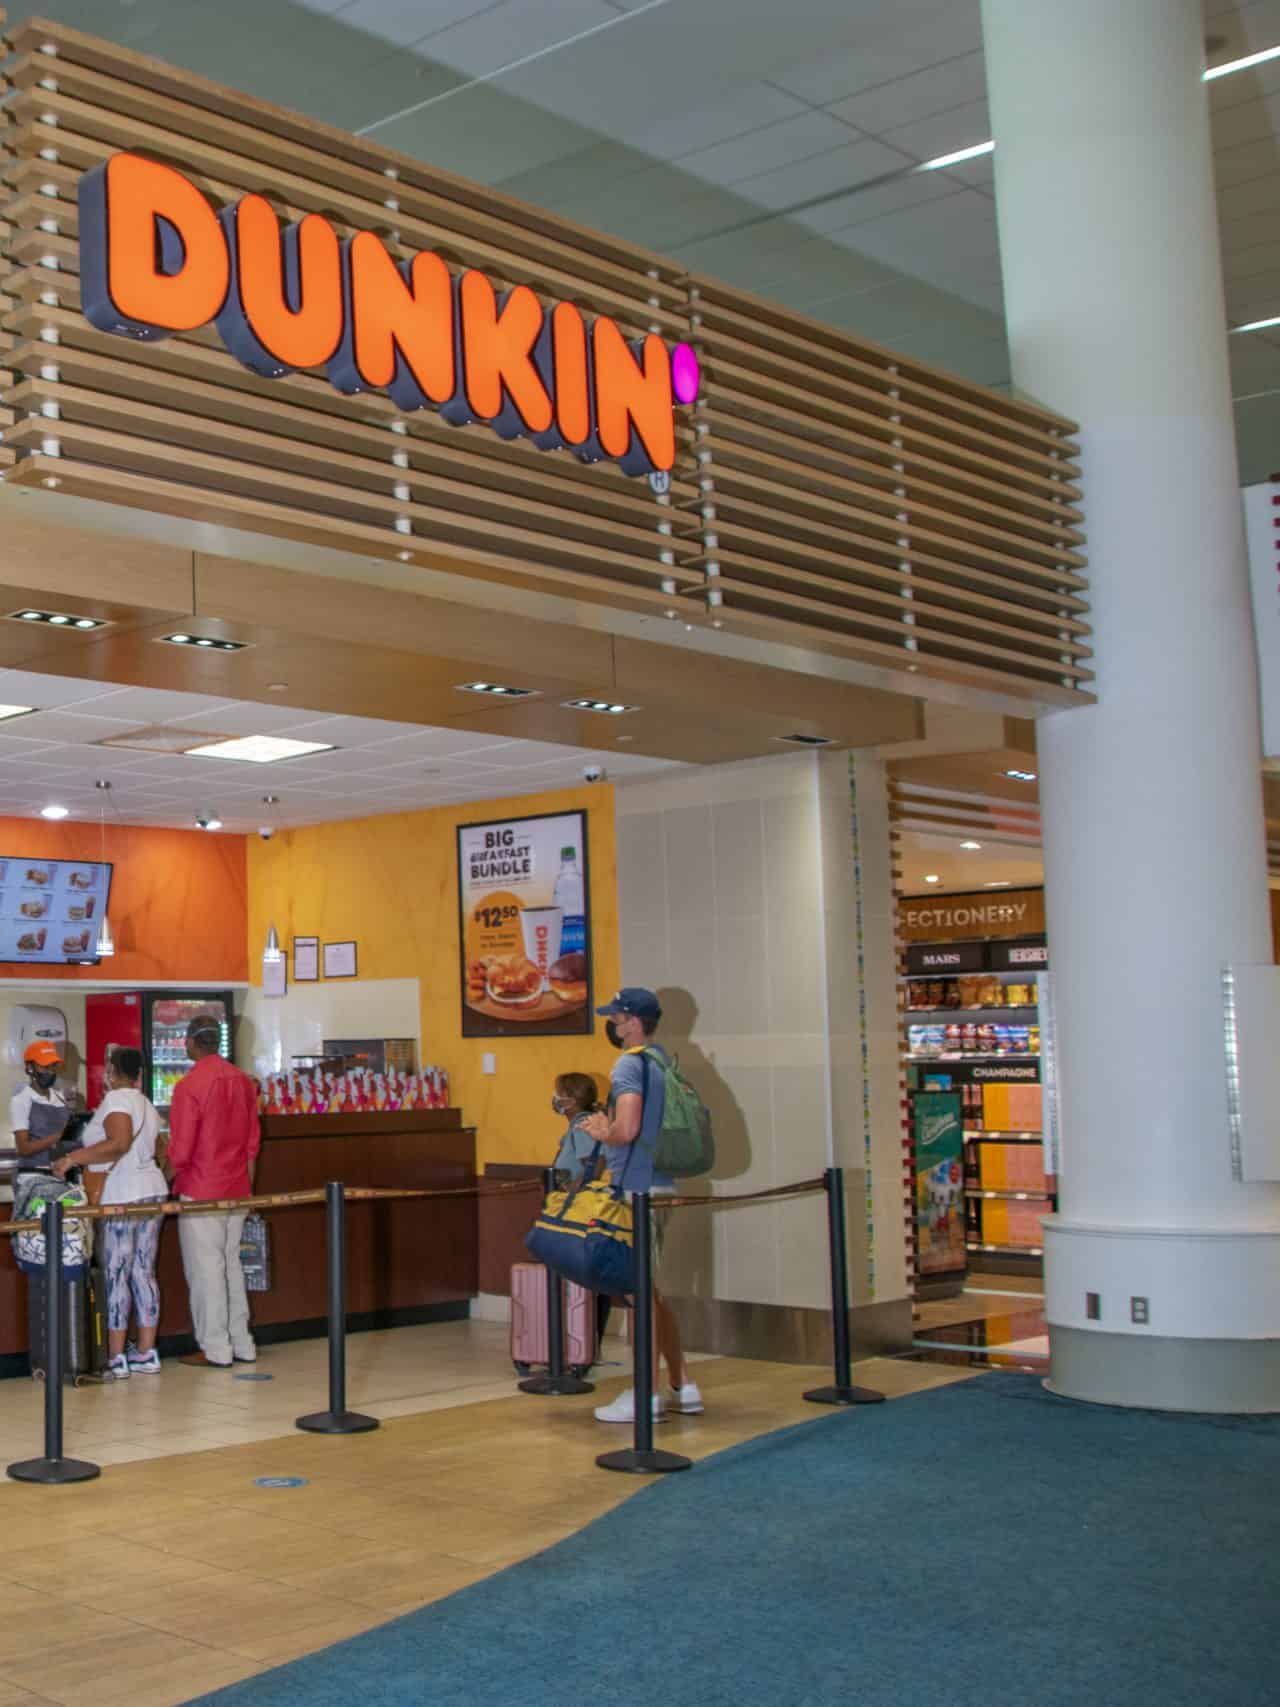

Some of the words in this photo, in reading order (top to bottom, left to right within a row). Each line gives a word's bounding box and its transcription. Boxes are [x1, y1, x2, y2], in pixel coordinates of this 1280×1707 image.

[106, 152, 700, 471] DUNKIN'
[485, 830, 514, 848] BIG
[471, 859, 531, 879] BUNDLE
[922, 953, 961, 965] MARS
[972, 1066, 1038, 1079] CHAMPAGNE
